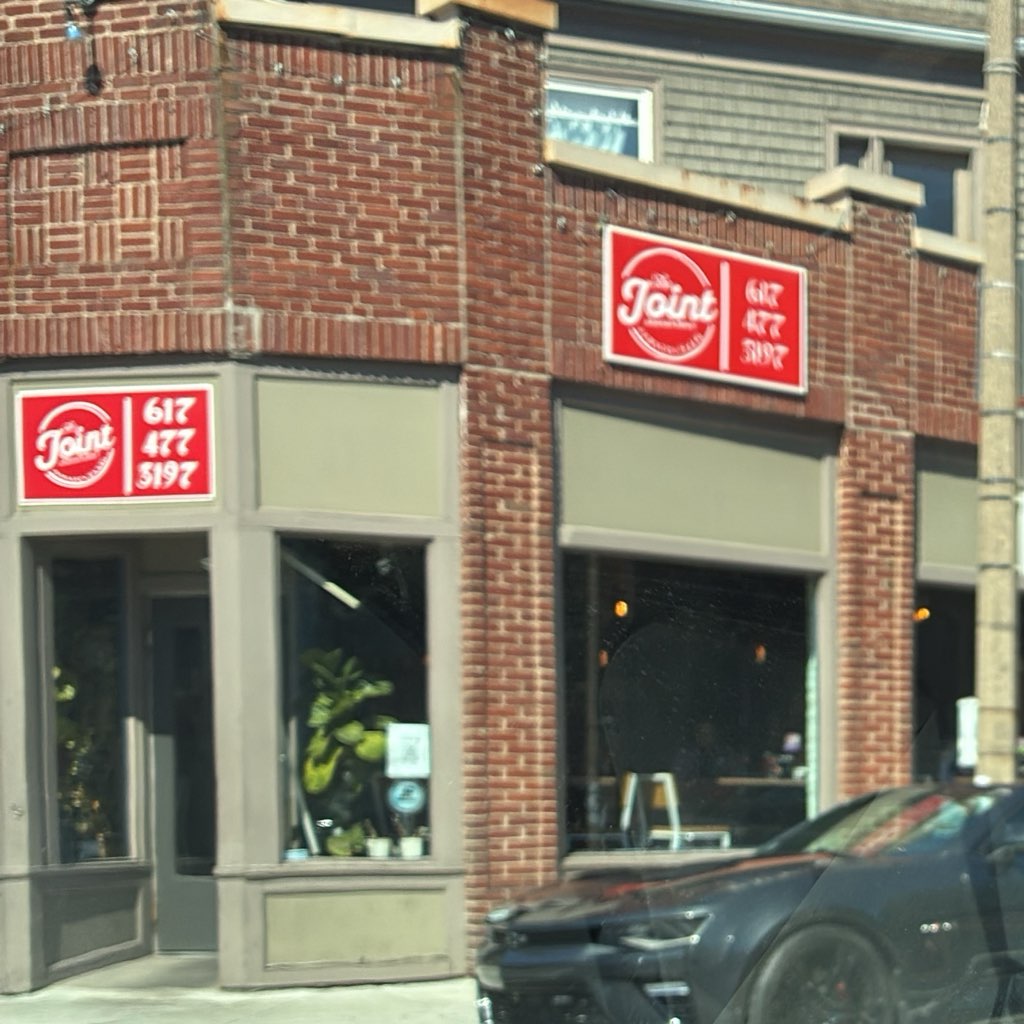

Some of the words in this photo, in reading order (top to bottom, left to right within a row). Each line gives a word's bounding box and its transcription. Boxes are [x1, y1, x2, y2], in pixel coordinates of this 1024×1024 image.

[617, 276, 718, 326] Joint
[745, 277, 784, 309] 617
[742, 308, 787, 338] 477
[143, 396, 197, 425] 617
[34, 423, 116, 471] Joint
[141, 428, 197, 457] 477
